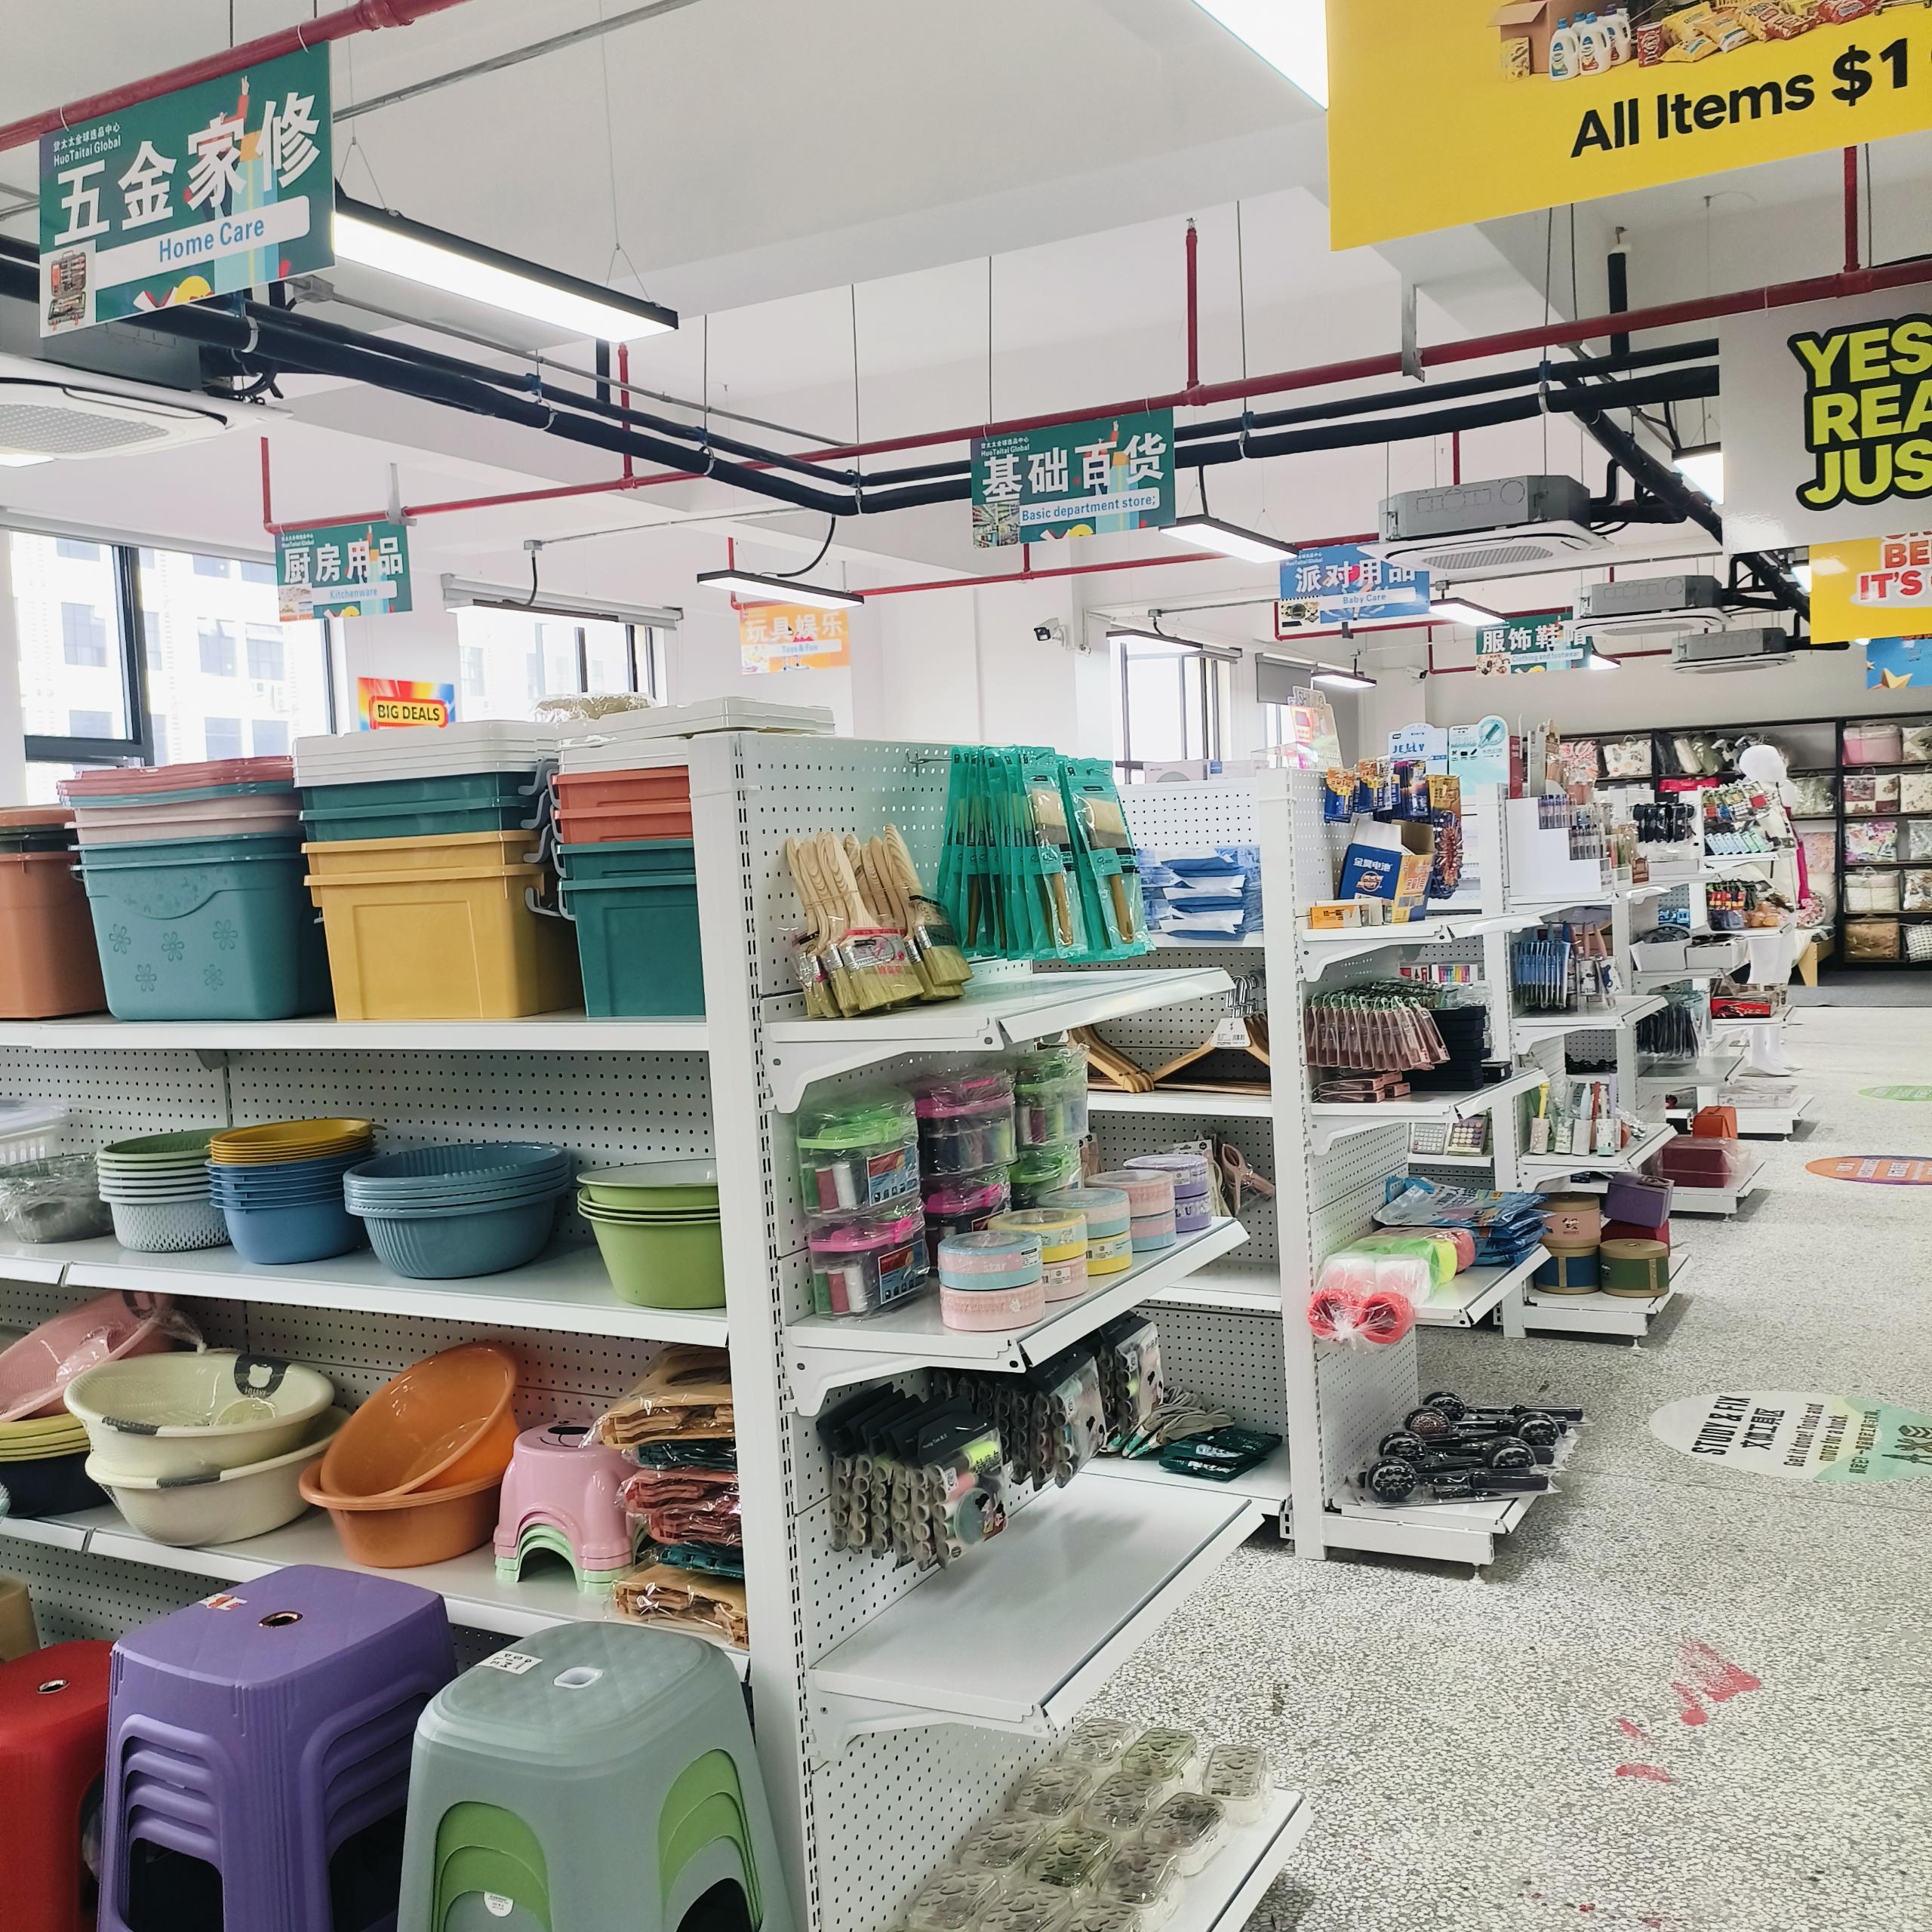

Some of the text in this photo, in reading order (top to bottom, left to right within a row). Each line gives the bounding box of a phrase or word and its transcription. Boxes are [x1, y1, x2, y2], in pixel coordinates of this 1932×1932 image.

[1571, 38, 1908, 158] All Items $1
[54, 134, 121, 167] HuoTaitai Global
[54, 91, 321, 246] 五金家修
[158, 219, 265, 263] Home Care
[1793, 318, 1932, 389] YES
[982, 432, 1167, 503] 基础百货
[1022, 508, 1051, 521] Basic
[1054, 500, 1120, 518] department
[285, 537, 404, 584] 厨房用品
[1884, 540, 1932, 569] BE
[329, 587, 378, 600] Kitchenware
[1860, 570, 1923, 600] IT'S
[1343, 595, 1364, 605] Baby
[746, 611, 843, 642] 玩具娱乐
[377, 704, 440, 721] BIG DEALS
[1796, 1415, 1820, 1429] Tools
[1805, 1403, 1824, 1414] and
[1691, 1395, 1751, 1455] STUDY & FIX
[1740, 1407, 1785, 1450] 文体工具区
[1790, 1431, 1814, 1448] done!
[1820, 1435, 1842, 1444] for
[1783, 1455, 1807, 1466] Get
[1819, 1444, 1840, 1461] more
